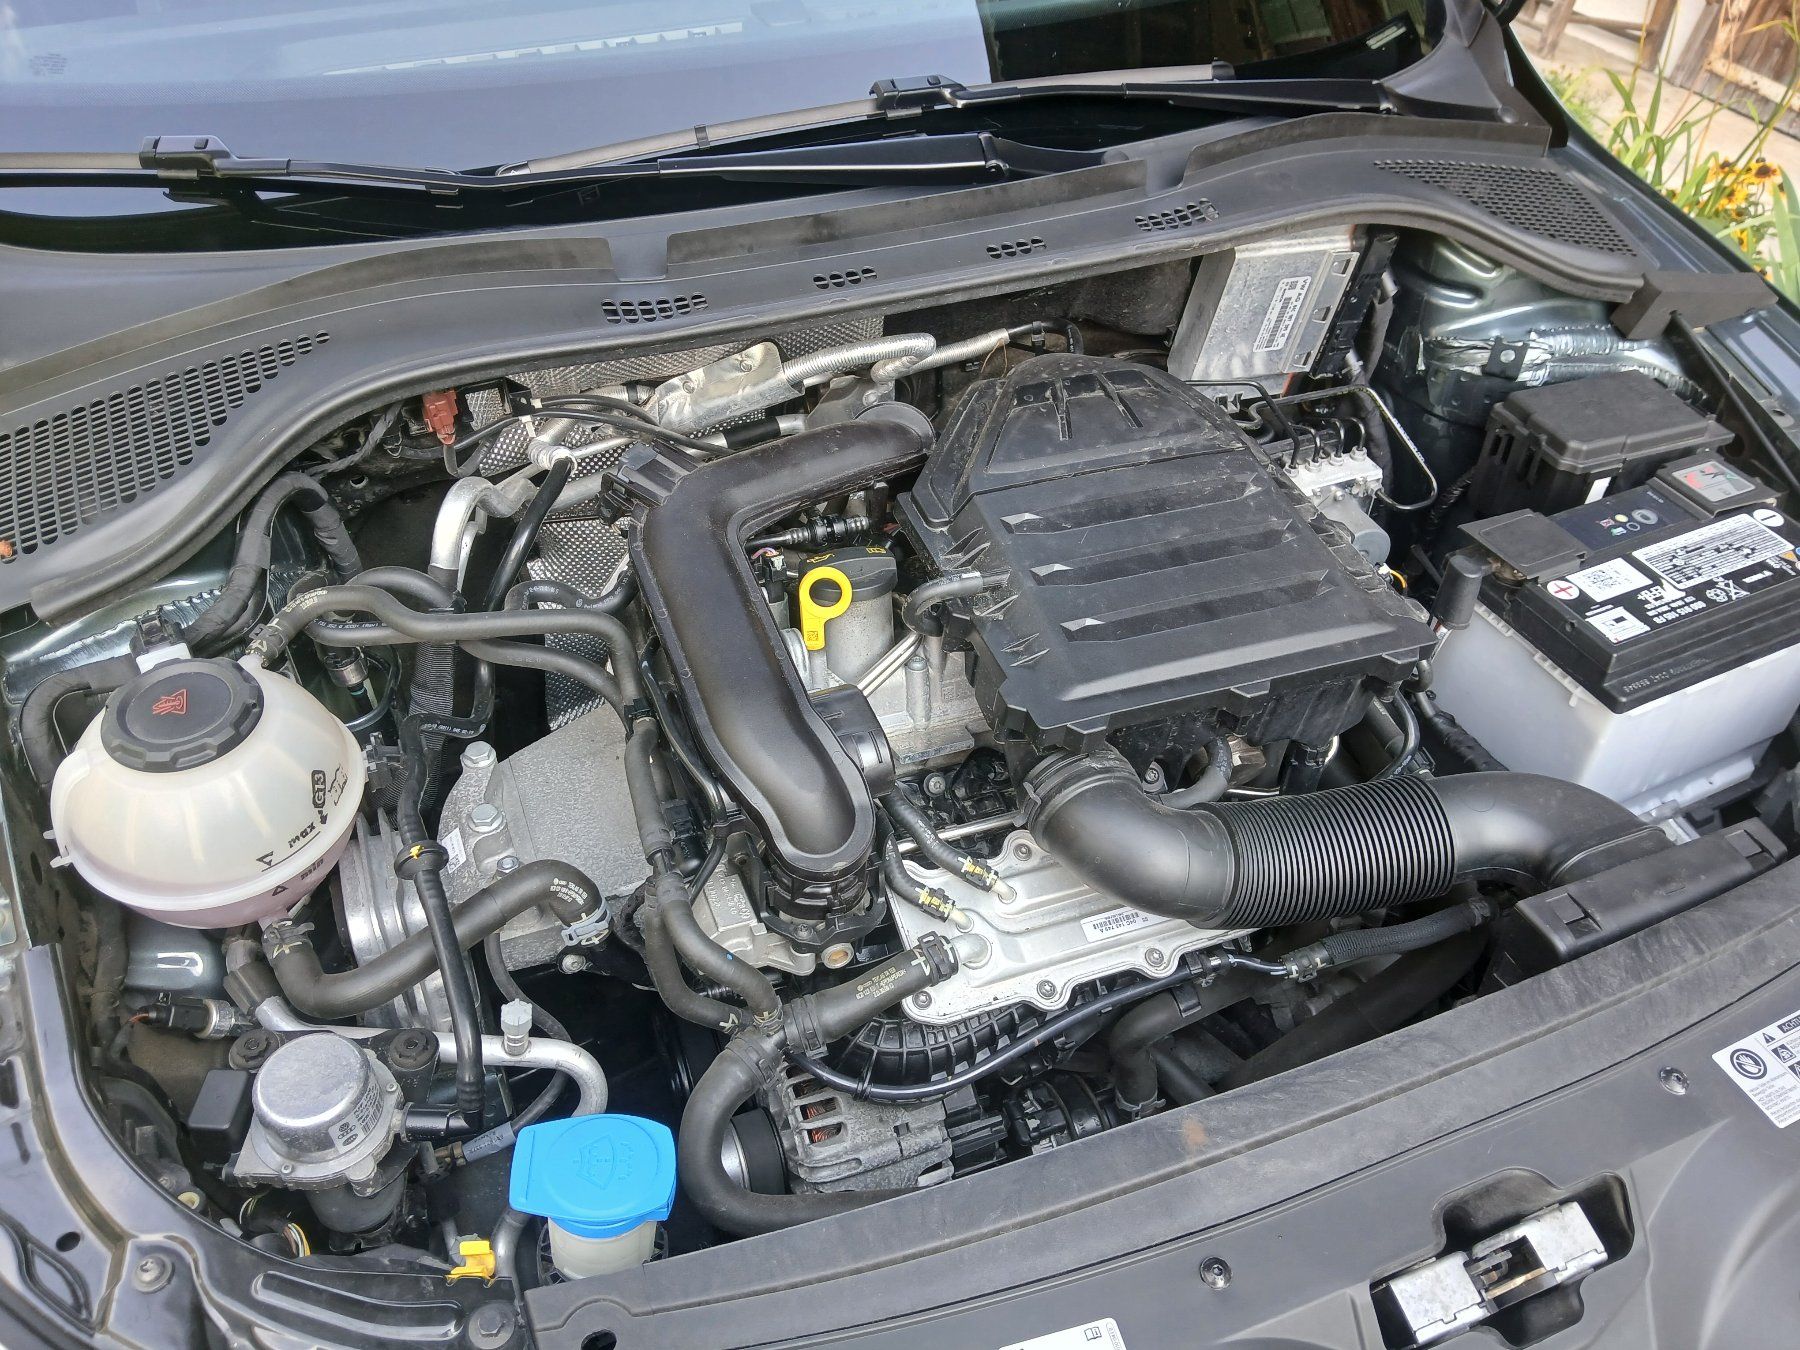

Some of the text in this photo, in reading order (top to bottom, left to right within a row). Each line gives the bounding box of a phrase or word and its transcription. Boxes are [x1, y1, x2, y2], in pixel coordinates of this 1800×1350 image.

[1299, 279, 1308, 289] VW
[314, 773, 325, 805] G13
[288, 821, 316, 848] max
